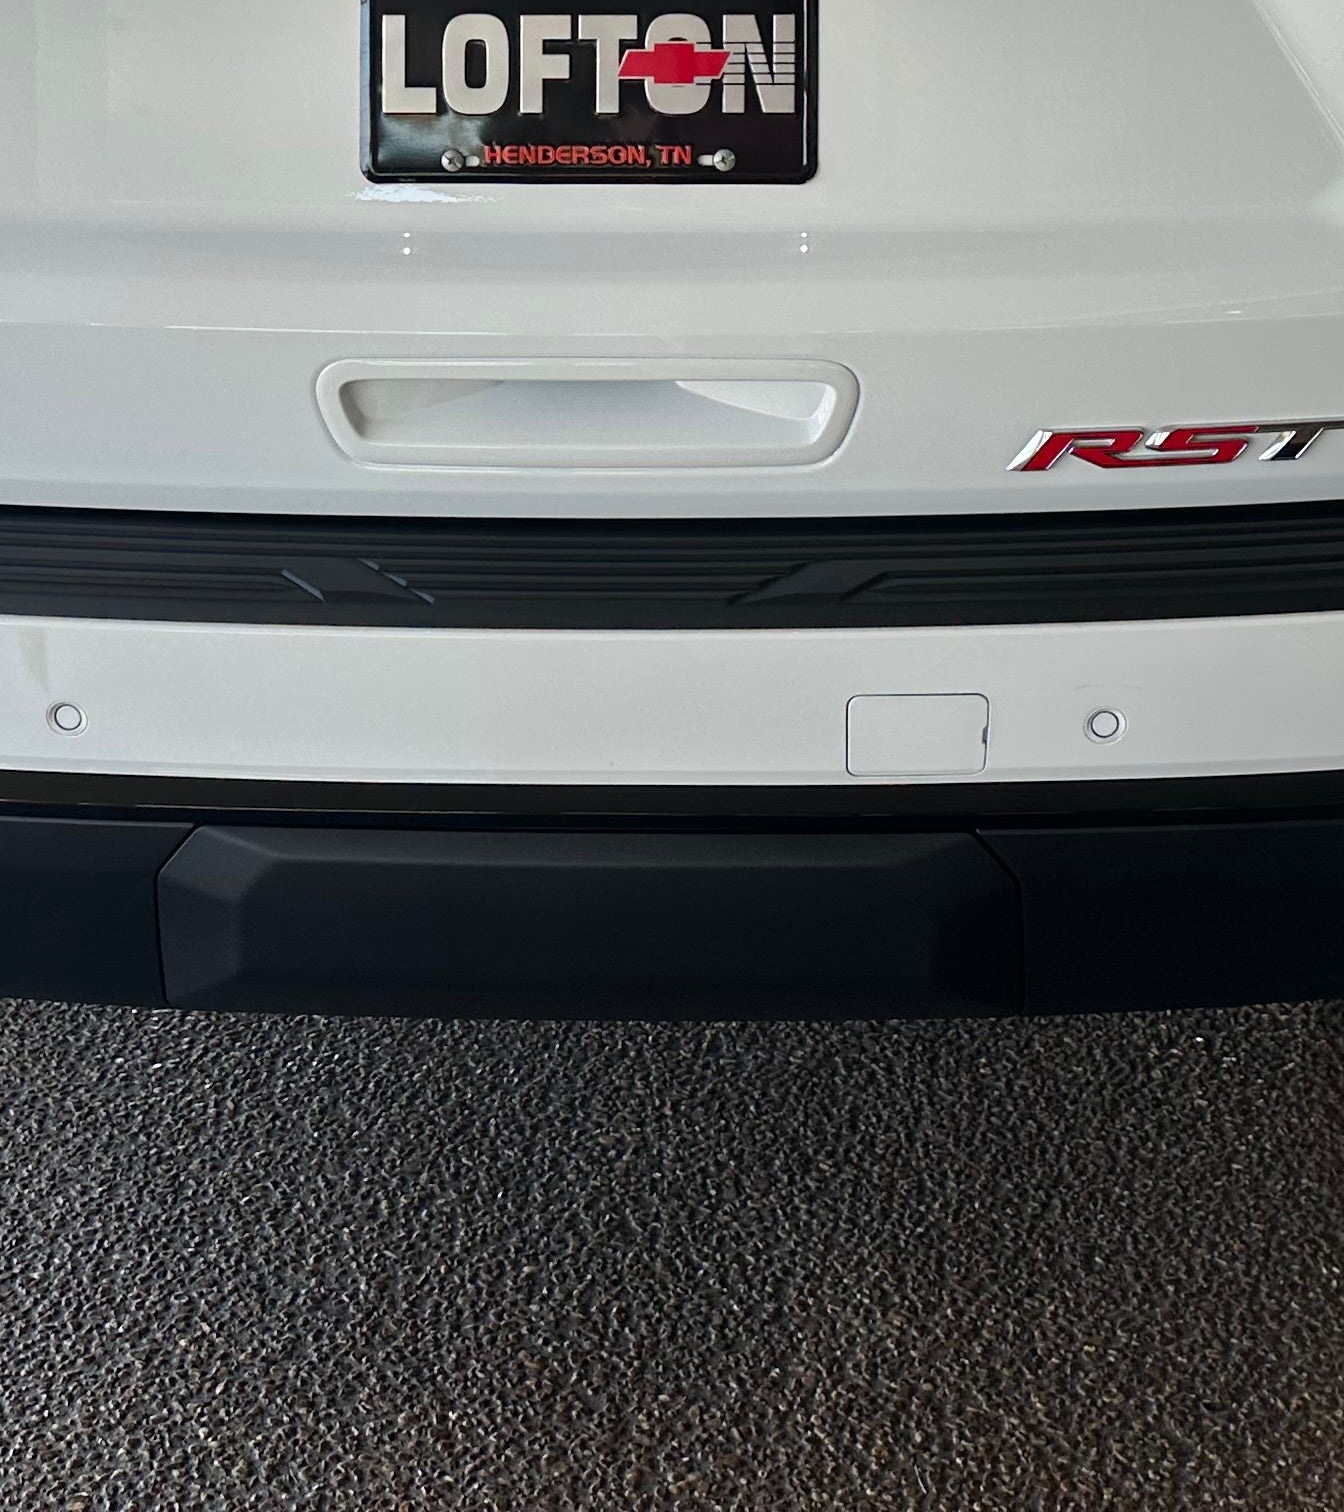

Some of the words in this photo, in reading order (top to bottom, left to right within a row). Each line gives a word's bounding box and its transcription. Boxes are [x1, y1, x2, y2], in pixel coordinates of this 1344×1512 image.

[380, 12, 796, 116] LOFTON
[483, 144, 652, 168] HENDERSON,
[655, 145, 693, 165] TN
